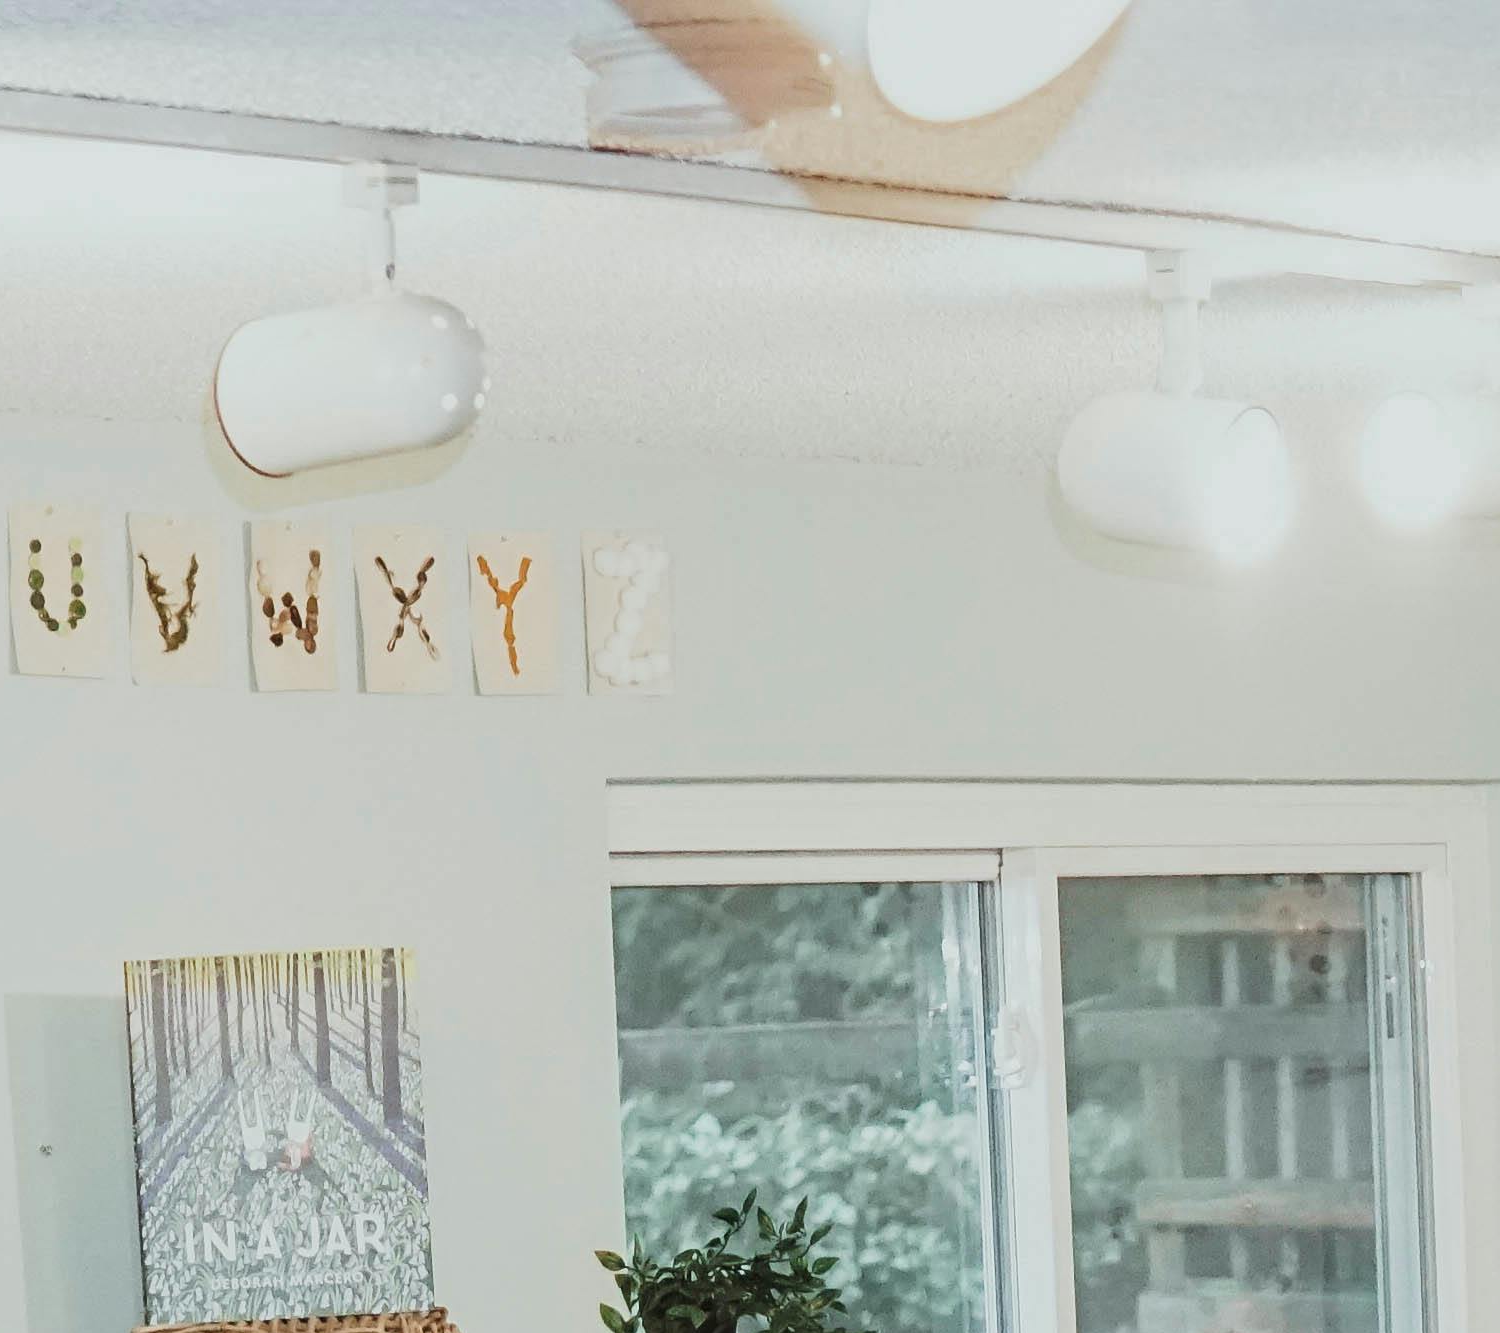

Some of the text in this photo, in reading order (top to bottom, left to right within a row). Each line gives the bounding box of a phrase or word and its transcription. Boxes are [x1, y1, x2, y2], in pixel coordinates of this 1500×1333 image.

[26, 537, 88, 635] U
[136, 550, 198, 655] V
[255, 548, 322, 656] W
[374, 554, 441, 662] X
[476, 554, 533, 677] Y
[592, 539, 672, 687] Z
[184, 1213, 388, 1264] IN A JAR
[211, 1270, 364, 1291] DEBORAH MARCERO
